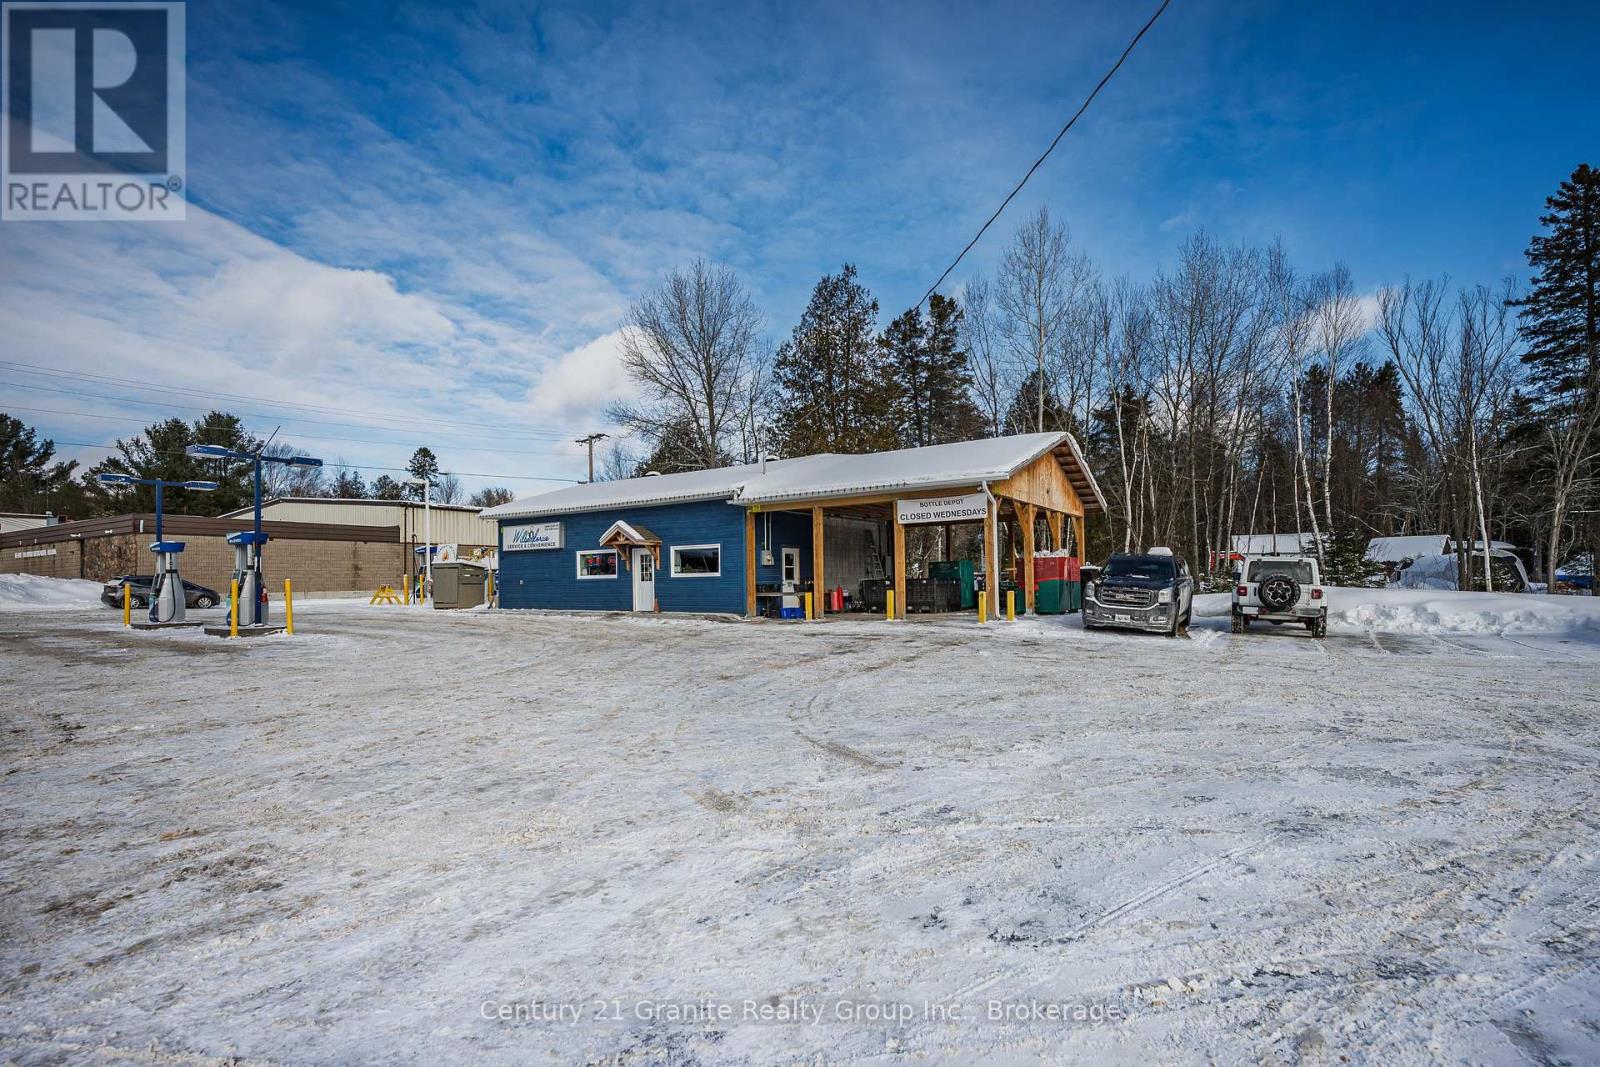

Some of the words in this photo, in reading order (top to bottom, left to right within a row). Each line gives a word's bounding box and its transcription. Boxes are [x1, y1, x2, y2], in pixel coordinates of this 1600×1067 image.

[919, 500, 941, 508] BOTTLE
[900, 512, 932, 521] CLOSED
[933, 507, 987, 519] WEDNESDAYS
[527, 541, 556, 549] CONVENIENCE
